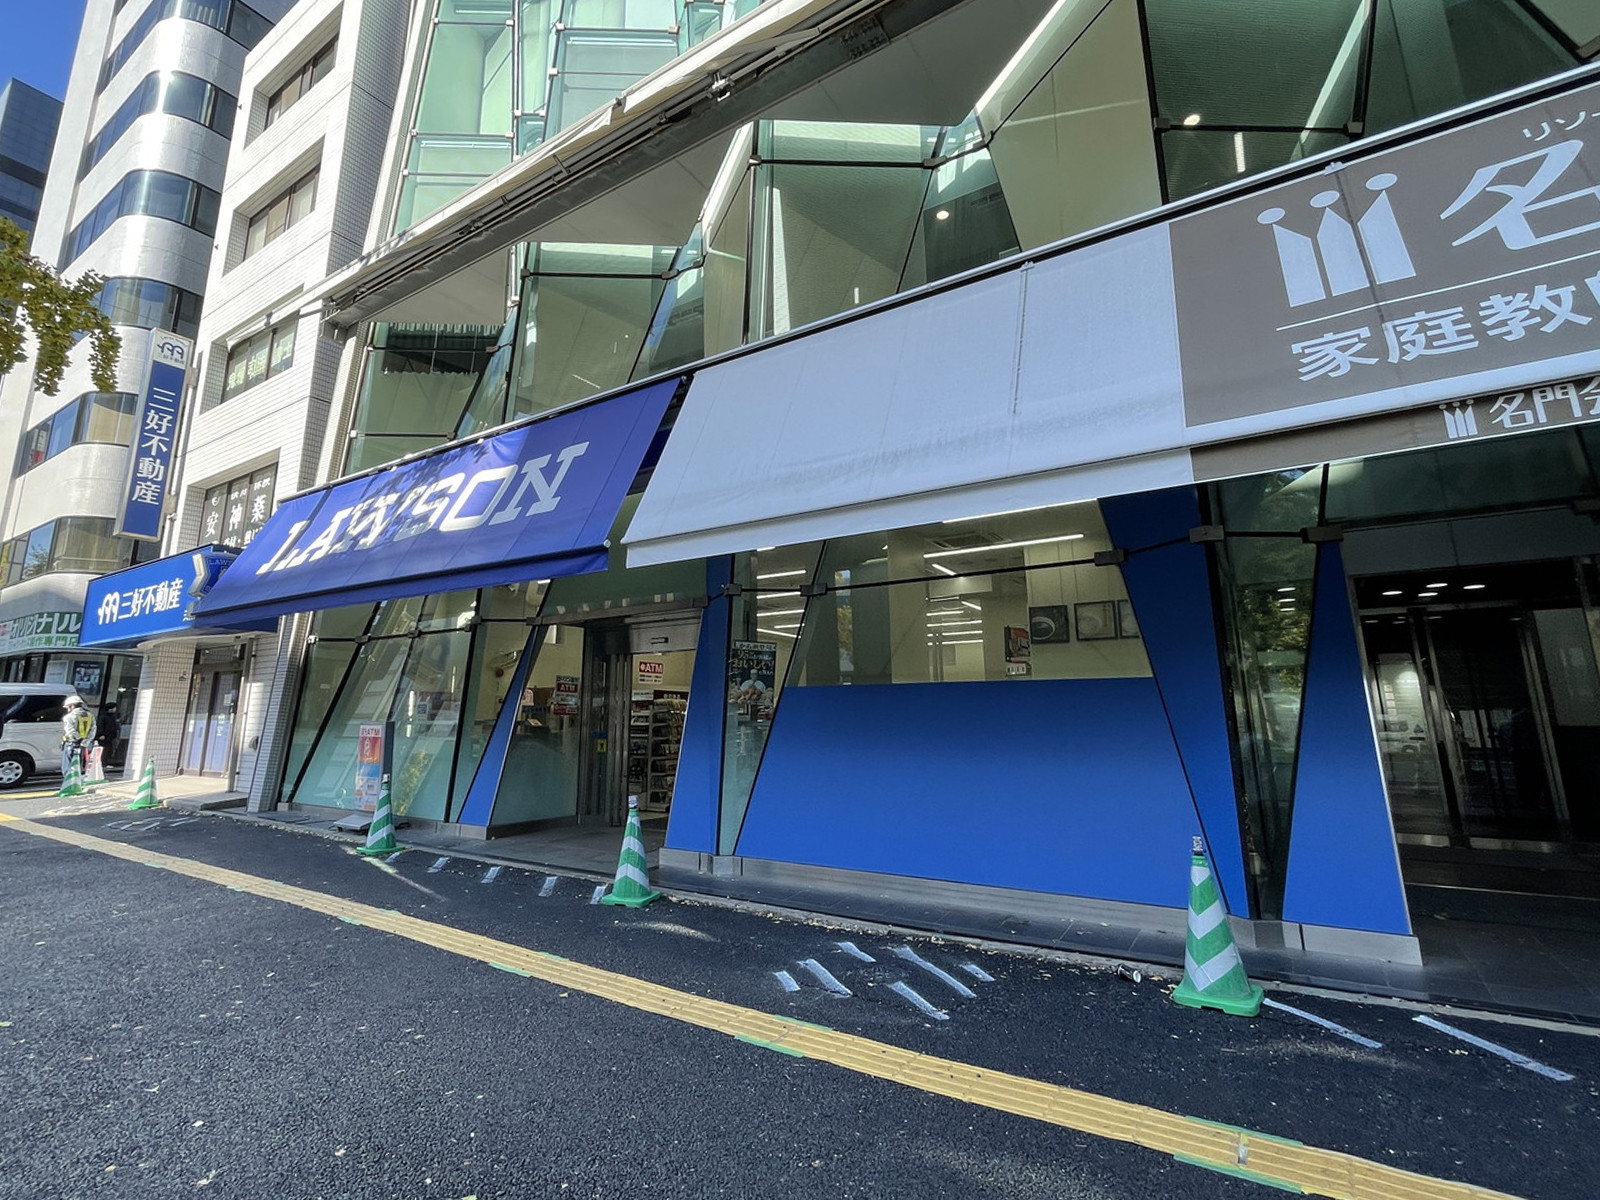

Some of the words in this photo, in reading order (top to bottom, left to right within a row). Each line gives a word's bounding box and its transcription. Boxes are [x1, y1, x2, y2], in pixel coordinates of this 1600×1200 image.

[1291, 270, 1600, 381] 家庭教
[131, 387, 176, 505] 三好不動産
[256, 441, 590, 575] LAWSON
[118, 577, 183, 620] 三好不動産
[645, 663, 663, 673] ATM
